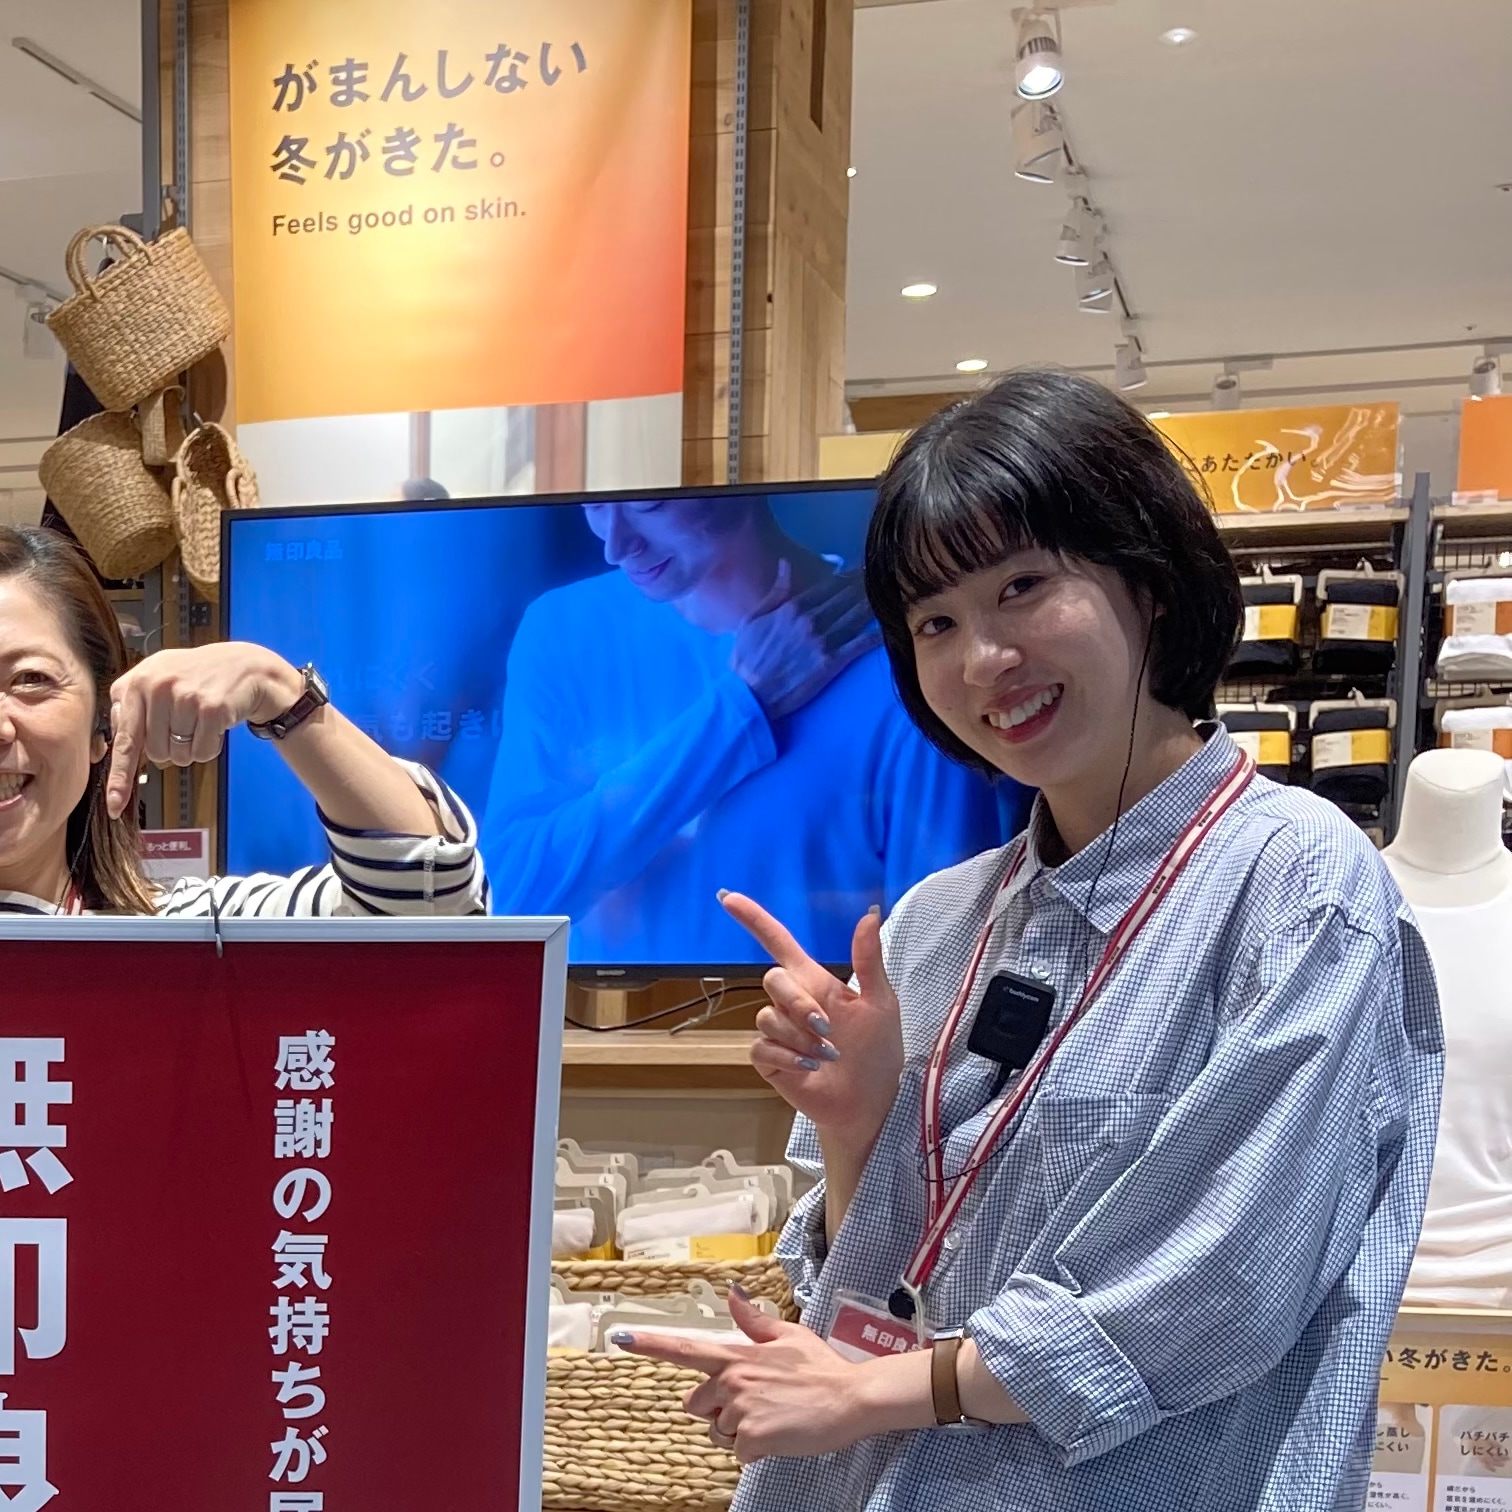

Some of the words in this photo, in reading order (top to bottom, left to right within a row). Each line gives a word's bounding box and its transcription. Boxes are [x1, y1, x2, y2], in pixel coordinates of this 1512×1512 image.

[271, 40, 588, 113] がまんしない
[269, 121, 506, 186] 冬がきた。
[272, 211, 339, 237] Feels
[347, 204, 414, 236] good
[422, 204, 456, 225] on
[463, 197, 527, 222] skin.
[264, 540, 344, 563] 無印良品
[1459, 1444, 1509, 1457] しにくい
